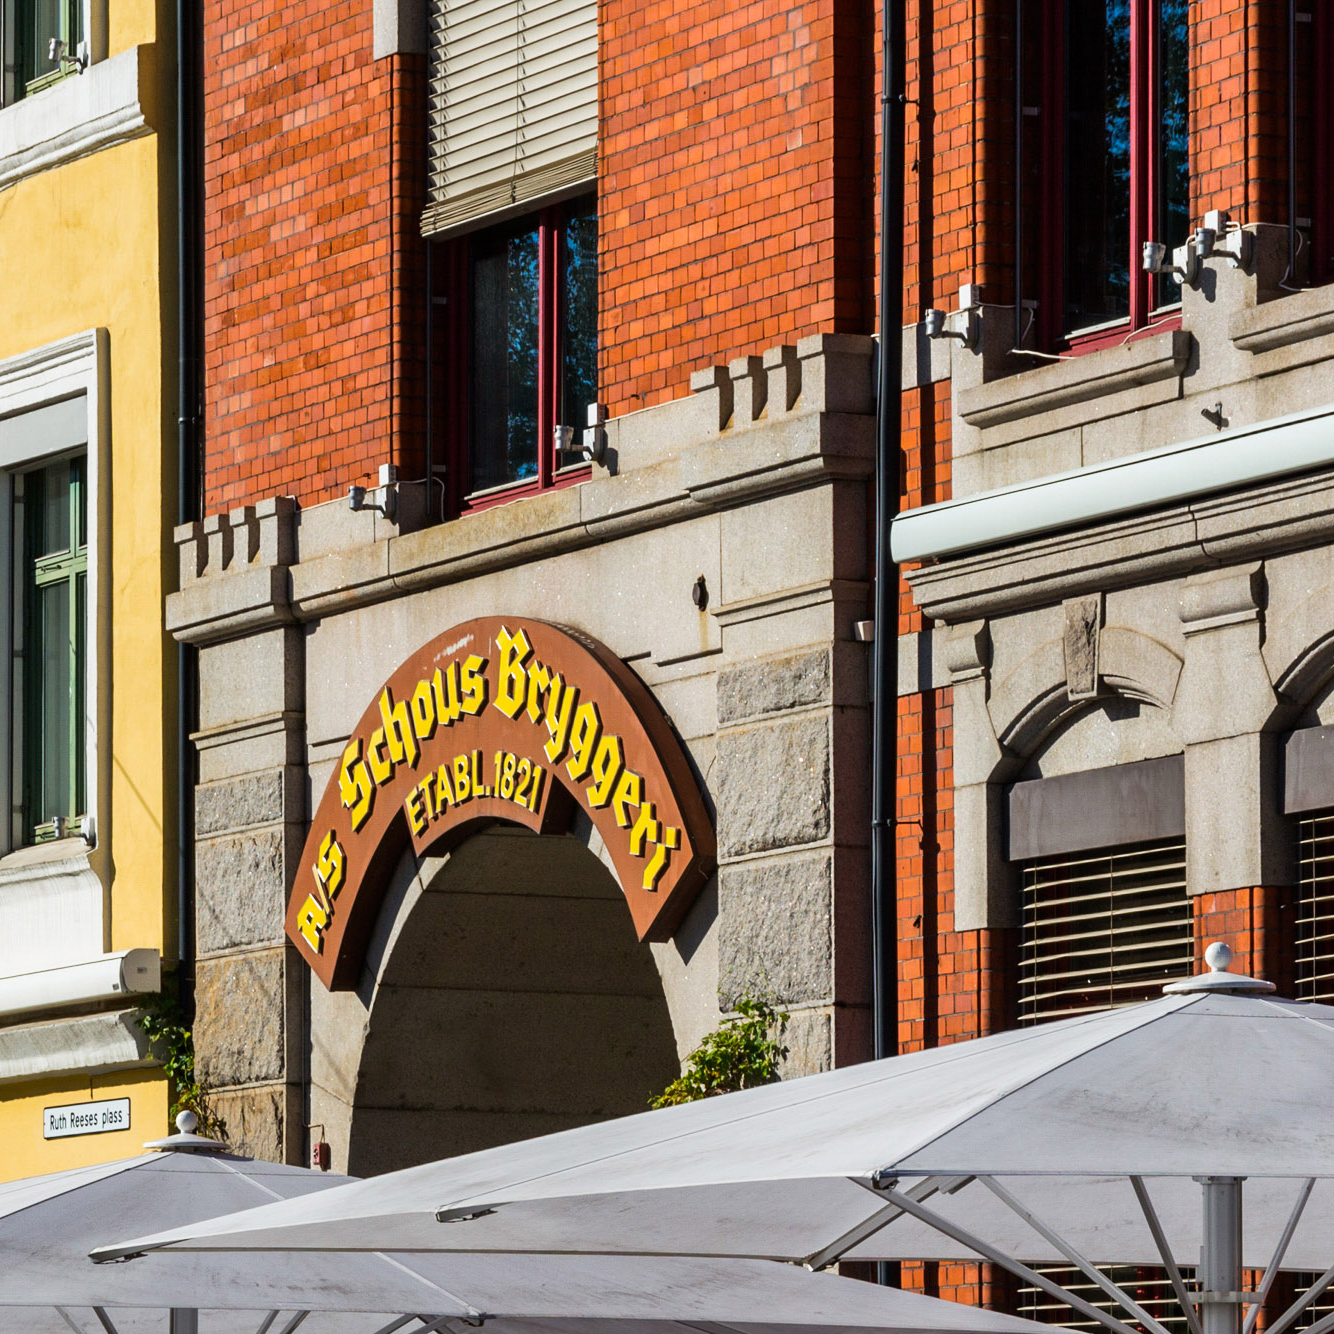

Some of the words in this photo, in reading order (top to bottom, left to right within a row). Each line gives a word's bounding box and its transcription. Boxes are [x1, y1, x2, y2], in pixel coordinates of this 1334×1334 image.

[339, 653, 489, 832] Schous
[493, 625, 677, 890] Bryggeri
[405, 749, 491, 836] ETABL.
[494, 750, 543, 813] 1821
[50, 1113, 67, 1131] Ruth
[70, 1112, 98, 1129] Reeses
[102, 1107, 123, 1129] plass
